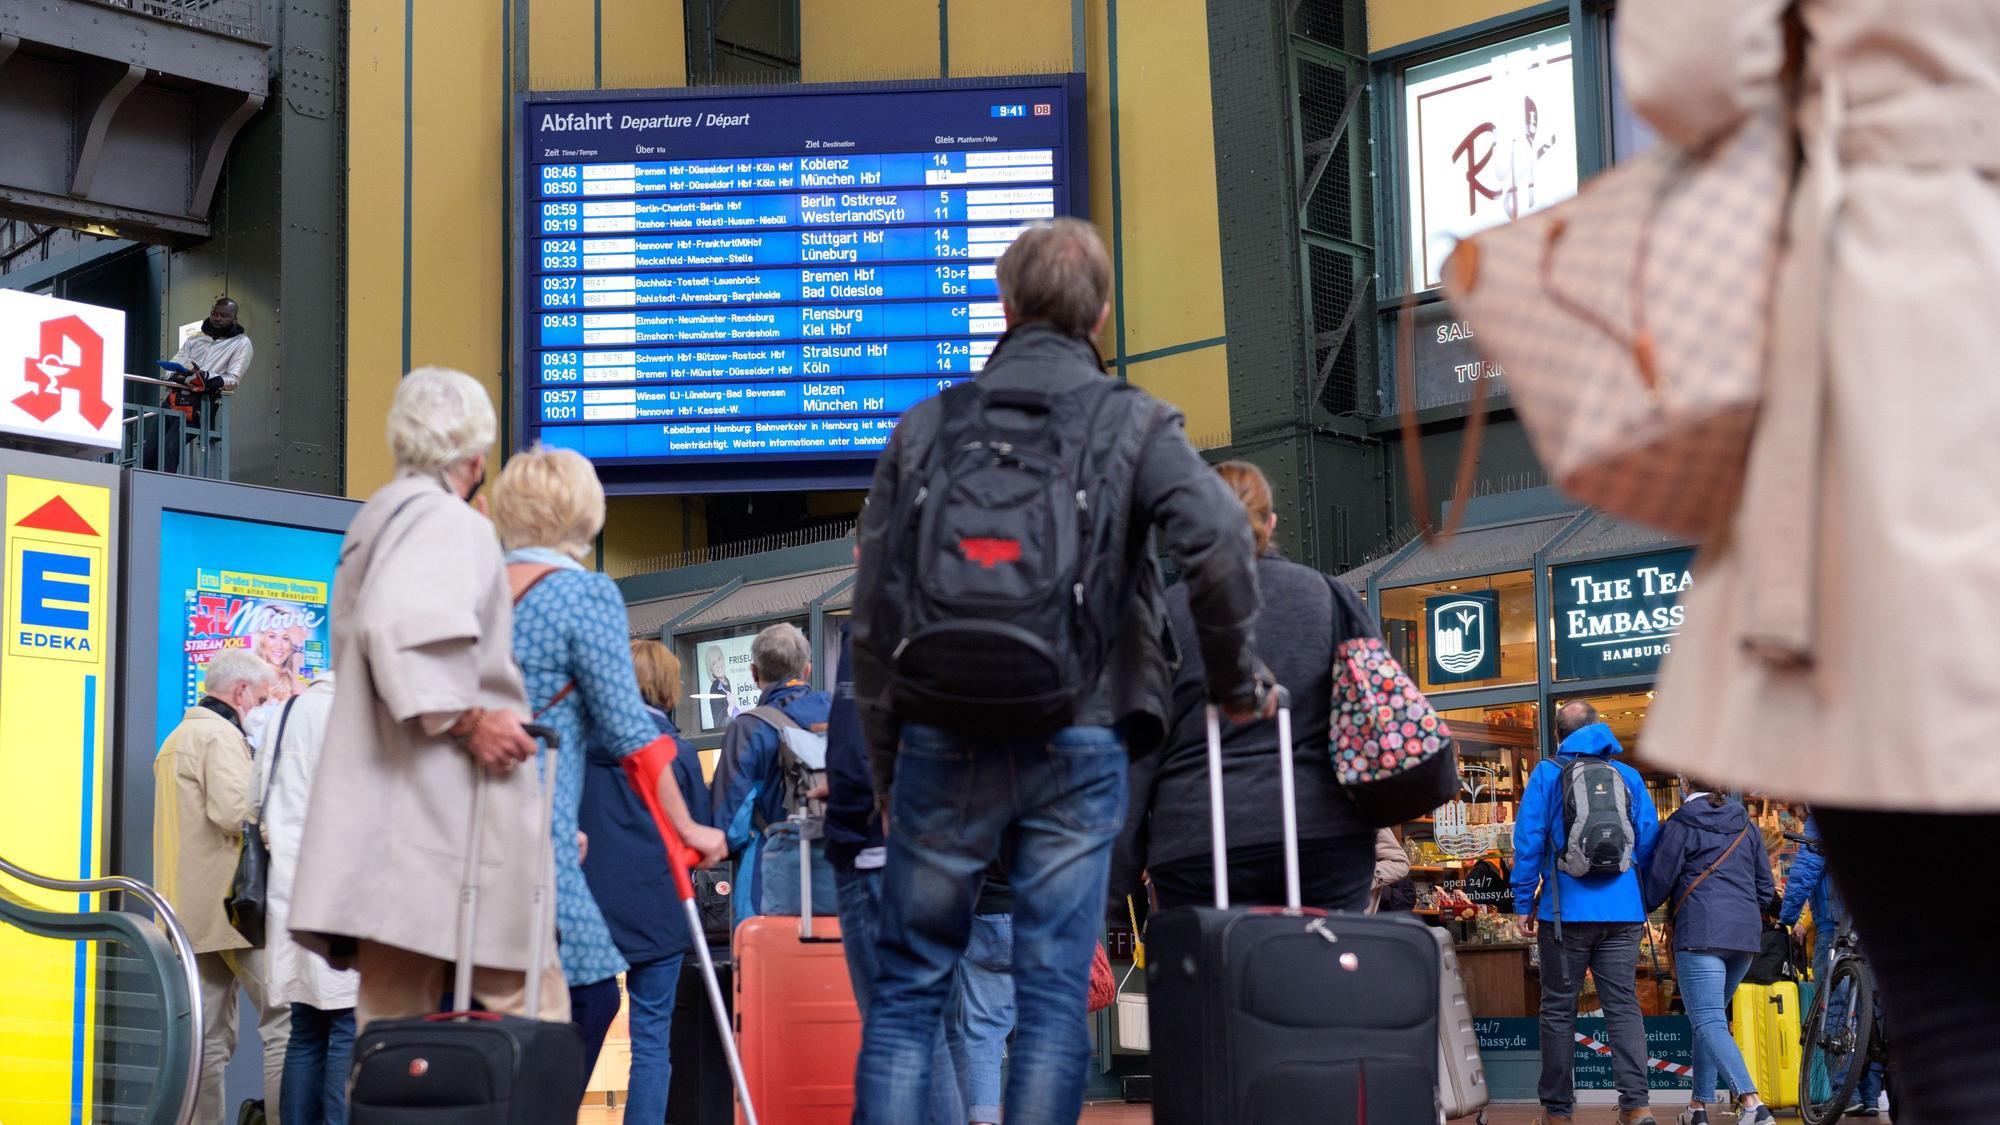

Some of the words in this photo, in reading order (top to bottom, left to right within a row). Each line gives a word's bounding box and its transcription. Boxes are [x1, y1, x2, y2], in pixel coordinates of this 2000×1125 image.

[1000, 106, 1022, 116] 9:41
[1035, 104, 1050, 115] DB
[541, 113, 613, 132] Abfahrt
[620, 115, 692, 129] Departure
[696, 113, 702, 127] /
[706, 113, 750, 127] Départ
[545, 149, 559, 157] Zeit
[562, 149, 597, 157] Time/Temps
[636, 145, 654, 154] Über
[805, 140, 820, 148] Ziel
[935, 136, 954, 144] Gleis
[544, 167, 576, 179] 08:46
[636, 167, 666, 176] Bremen
[778, 163, 793, 172] Hbf
[801, 158, 848, 170] Koblenz
[933, 155, 948, 166] 14
[544, 182, 577, 194] 08:50
[636, 183, 666, 192] Bremen
[779, 178, 793, 187] Hbf
[801, 173, 854, 185] München
[861, 171, 880, 184] Hbf
[937, 170, 948, 181] 14
[544, 204, 577, 216] 08:59
[728, 201, 742, 210] Hbf
[801, 196, 835, 207] Berlin
[842, 194, 896, 206] Ostkreuz
[941, 192, 948, 203] 5
[544, 219, 577, 231] 09:19
[802, 209, 905, 224] Westerland(Sylt)
[934, 208, 948, 219] 11
[544, 241, 576, 253] 09:24
[636, 241, 673, 250] Hannover
[802, 231, 857, 247] Stuttgart
[863, 231, 884, 243] Hbf
[934, 230, 949, 241] 14
[544, 256, 577, 268] 09:33
[802, 248, 857, 262] Lüneburg
[544, 278, 576, 290] 09:37
[802, 270, 850, 282] Bremen
[854, 269, 874, 280] Hbf
[544, 293, 576, 305] 09:41
[802, 286, 824, 298] Bad
[830, 286, 883, 297] Oldesloe
[942, 283, 950, 294] 6
[544, 315, 577, 327] 09:43
[803, 309, 862, 322] Flensburg
[952, 308, 966, 317] C-F
[803, 324, 827, 336] Kiel
[831, 323, 851, 335] Hbf
[544, 353, 577, 365] 09:43
[636, 354, 674, 363] Schwerin
[771, 350, 785, 359] Hbf
[803, 345, 862, 358] Stralsund
[867, 345, 887, 357] Hbf
[544, 369, 577, 381] 09:46
[636, 370, 667, 378] Bremen
[778, 366, 793, 374] Hbf
[803, 361, 830, 373] Köln
[937, 358, 951, 370] 14
[544, 391, 576, 403] 09:57
[637, 391, 666, 400] Winsen
[746, 388, 786, 397] Bevensen
[804, 384, 844, 396] Uelzen
[545, 407, 576, 418] 10:01
[636, 408, 674, 416] Hannover
[804, 399, 857, 411] München
[864, 398, 884, 410] Hbf
[663, 425, 710, 434] Kabelbrand
[756, 422, 807, 431] Bahnverkehr
[811, 422, 818, 431] in
[822, 421, 858, 431] Hamburg
[862, 420, 873, 429] ist
[877, 420, 898, 429] aktu
[670, 438, 729, 451] beeinträchtigt.
[733, 438, 765, 448] Weitere
[770, 438, 825, 448] Informationen
[829, 437, 850, 446] unter
[854, 436, 890, 446] bahnhof.
[21, 550, 90, 630] E
[1571, 576, 1632, 604] THE
[1637, 567, 1694, 596] TEA
[200, 596, 242, 635] TV
[224, 600, 326, 636] Movie
[1567, 606, 1688, 638] EMBASS
[20, 632, 90, 652] EDEKA
[1603, 644, 1672, 661] HAMBURG
[1444, 880, 1466, 888] open
[1470, 876, 1492, 888] 24/7
[1474, 1020, 1500, 1034] 24/7
[1575, 1080, 1594, 1088] stag
